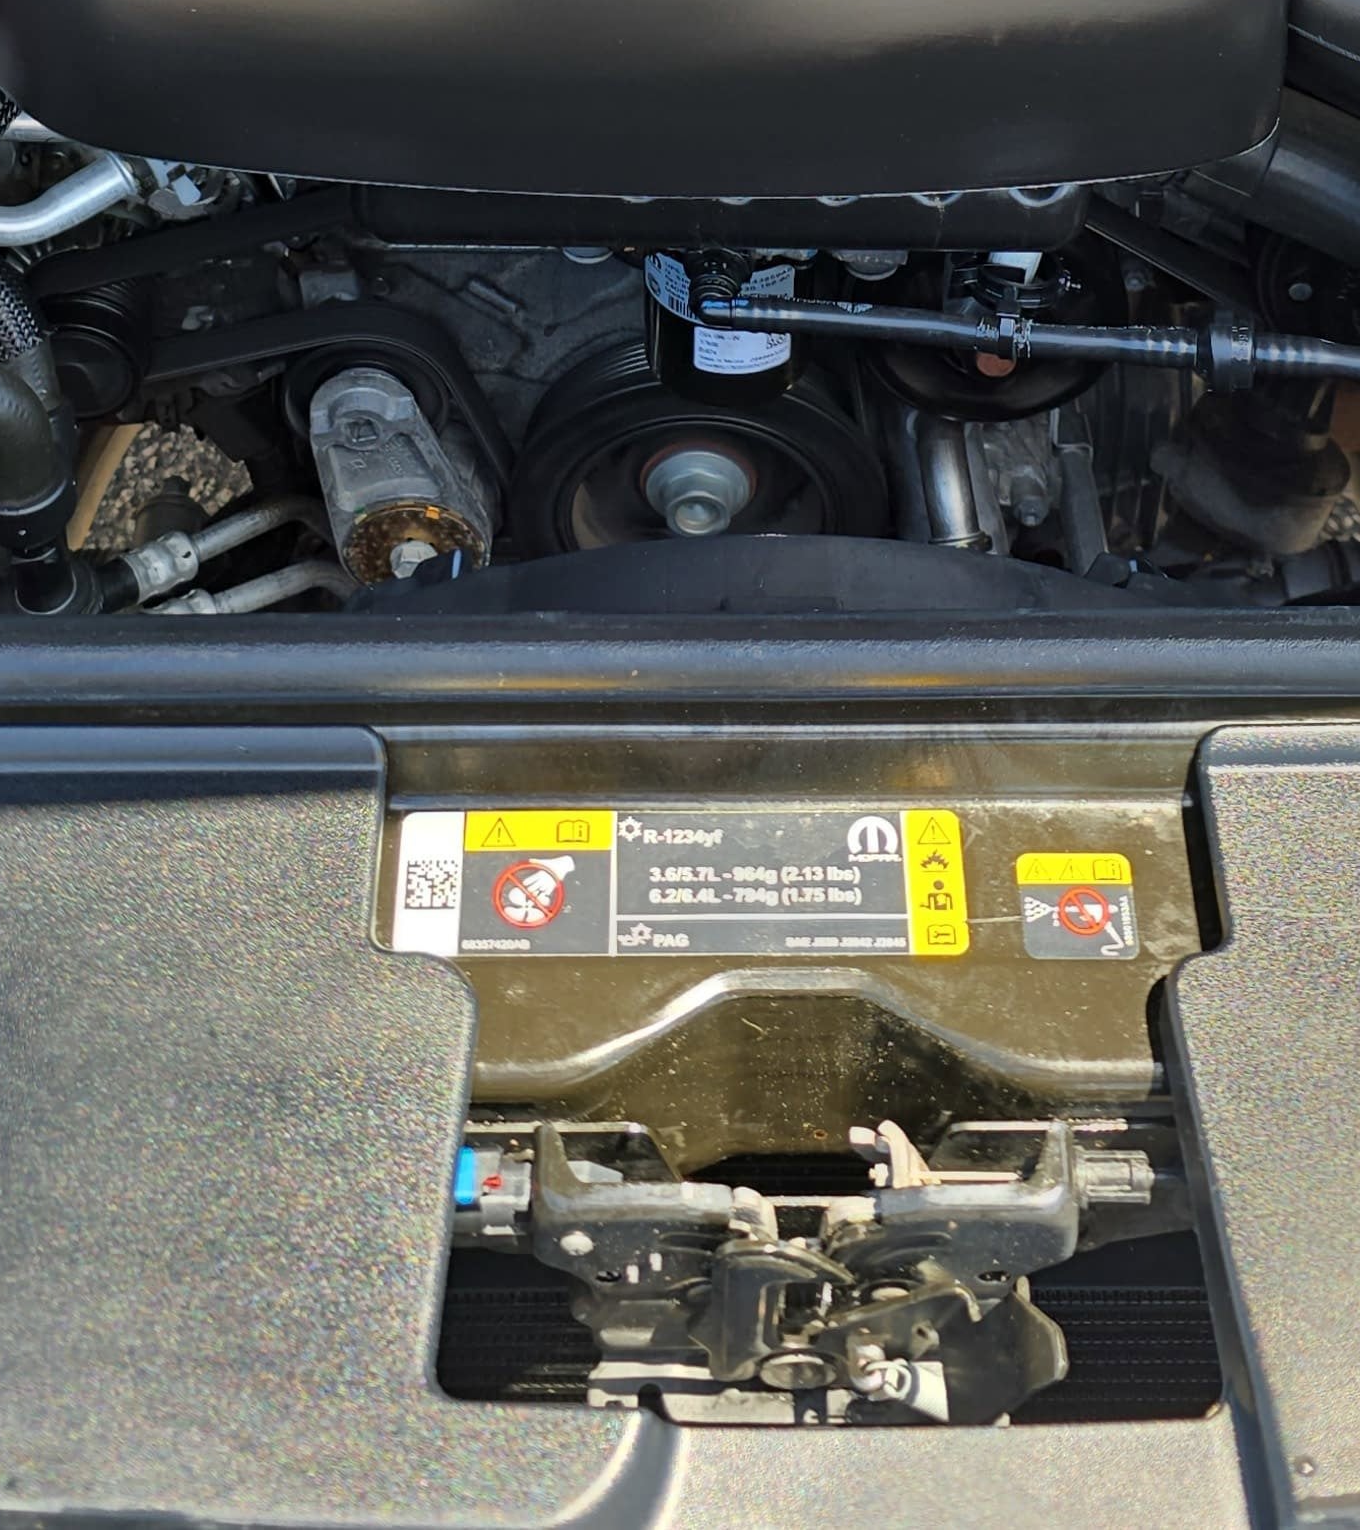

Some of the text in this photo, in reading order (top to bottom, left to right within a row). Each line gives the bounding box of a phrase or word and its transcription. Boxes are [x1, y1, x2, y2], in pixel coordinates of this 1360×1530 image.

[643, 828, 724, 848] R-1234yf
[781, 866, 824, 885] (2.13
[826, 866, 861, 885] lbs)
[781, 887, 826, 906] (1.75
[827, 887, 862, 906] lbs)
[652, 932, 690, 948] PAG
